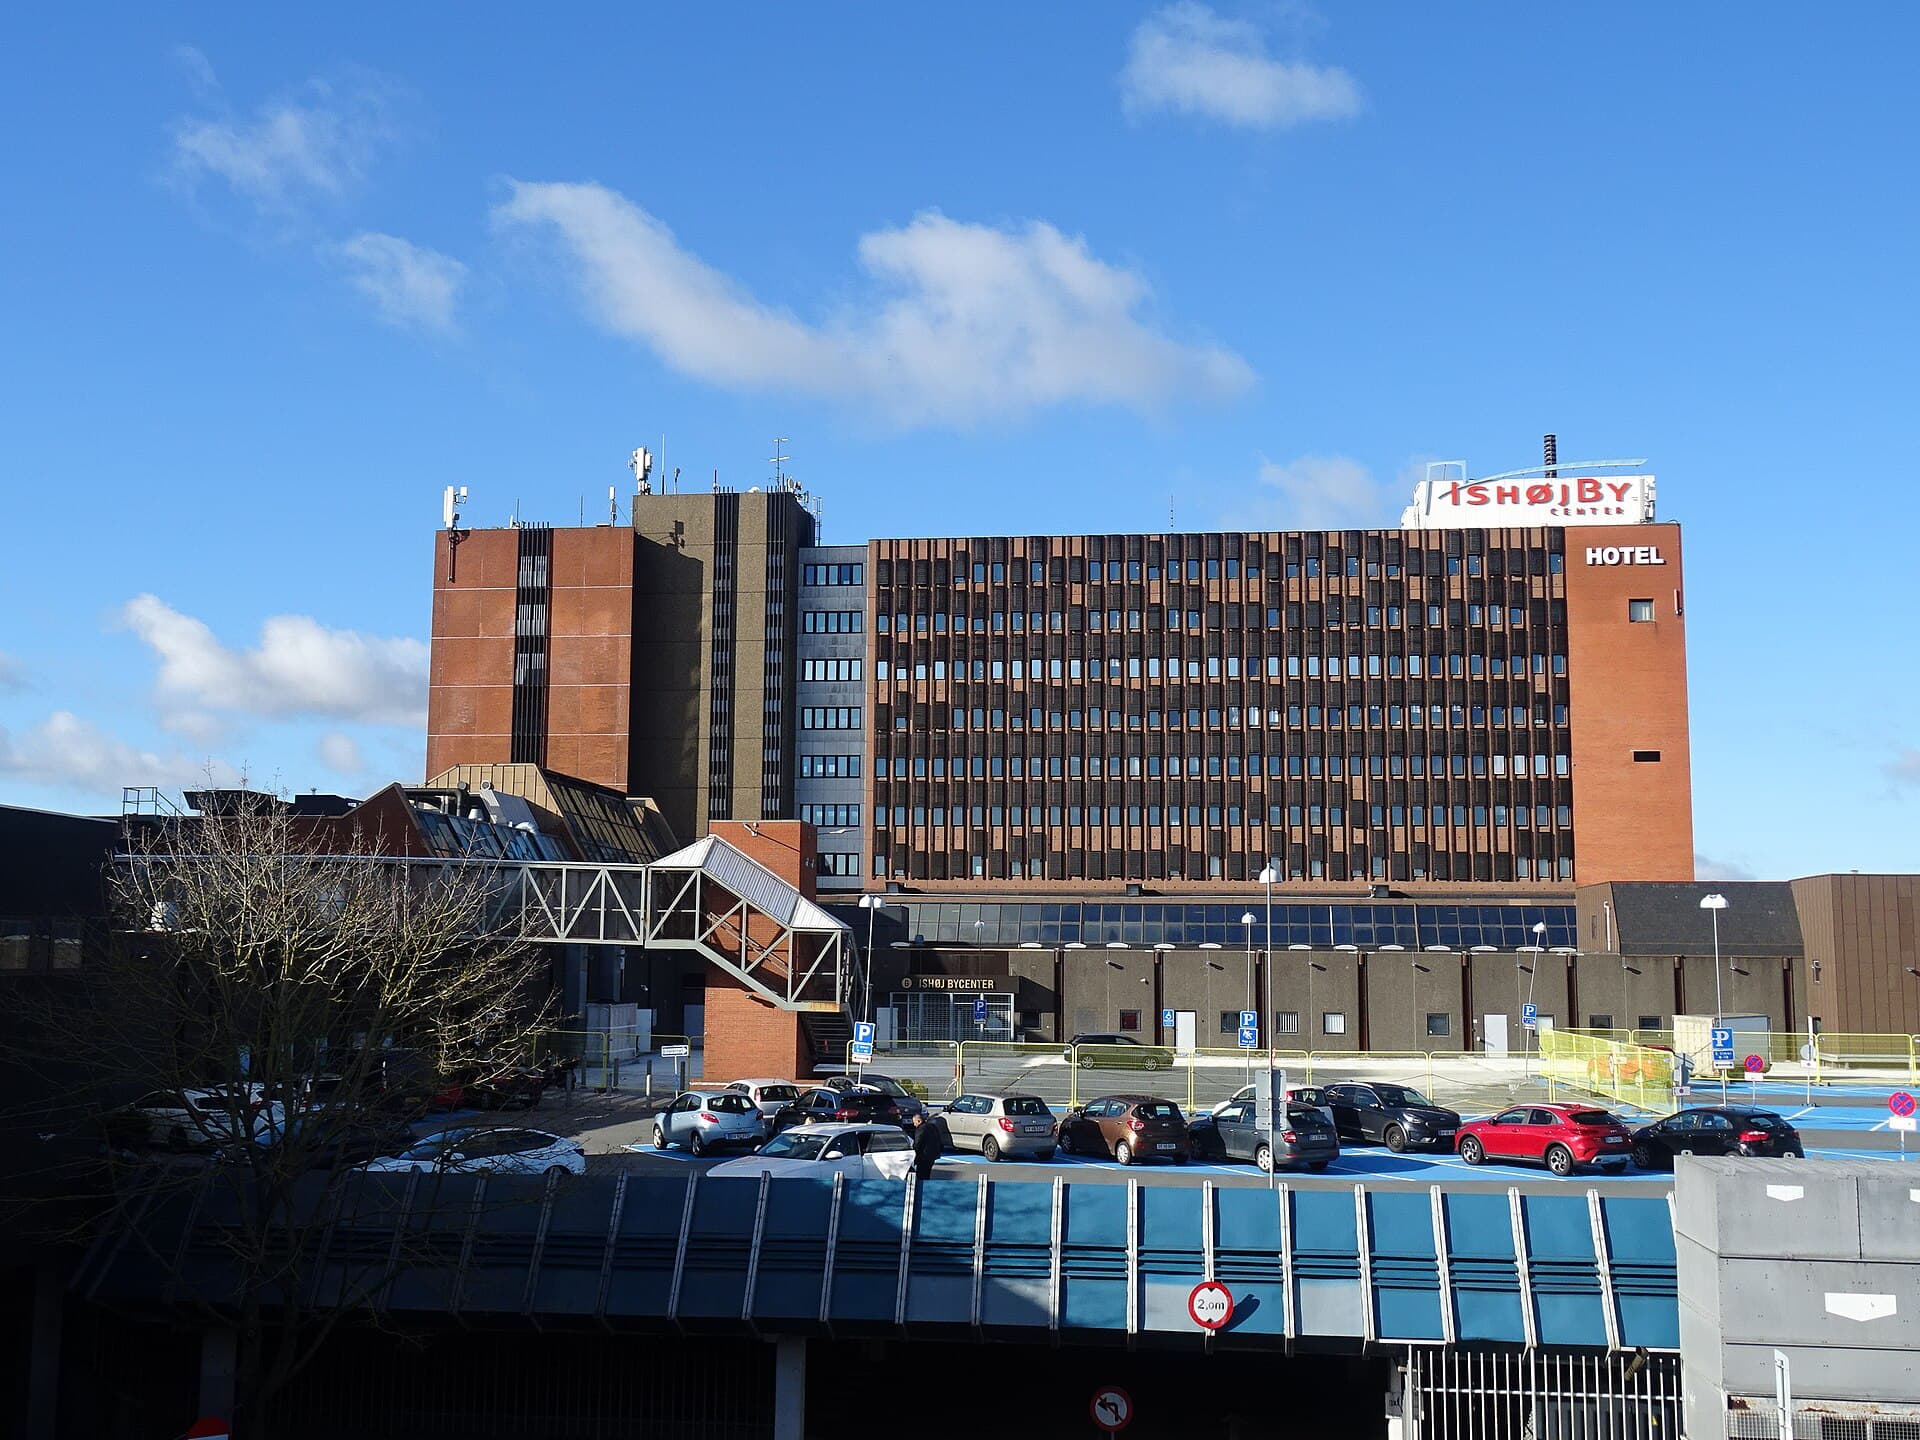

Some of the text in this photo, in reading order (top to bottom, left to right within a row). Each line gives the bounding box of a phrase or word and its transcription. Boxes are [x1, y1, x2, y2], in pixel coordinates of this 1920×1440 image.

[1550, 507, 1624, 516] CENTER
[1586, 546, 1664, 565] HOTEL
[919, 978, 994, 989] ISHØJ BYCENTER
[977, 1001, 985, 1011] P
[1525, 1005, 1534, 1016] P
[1243, 1013, 1254, 1026] P
[858, 1024, 870, 1041] P
[1714, 1030, 1729, 1047] P
